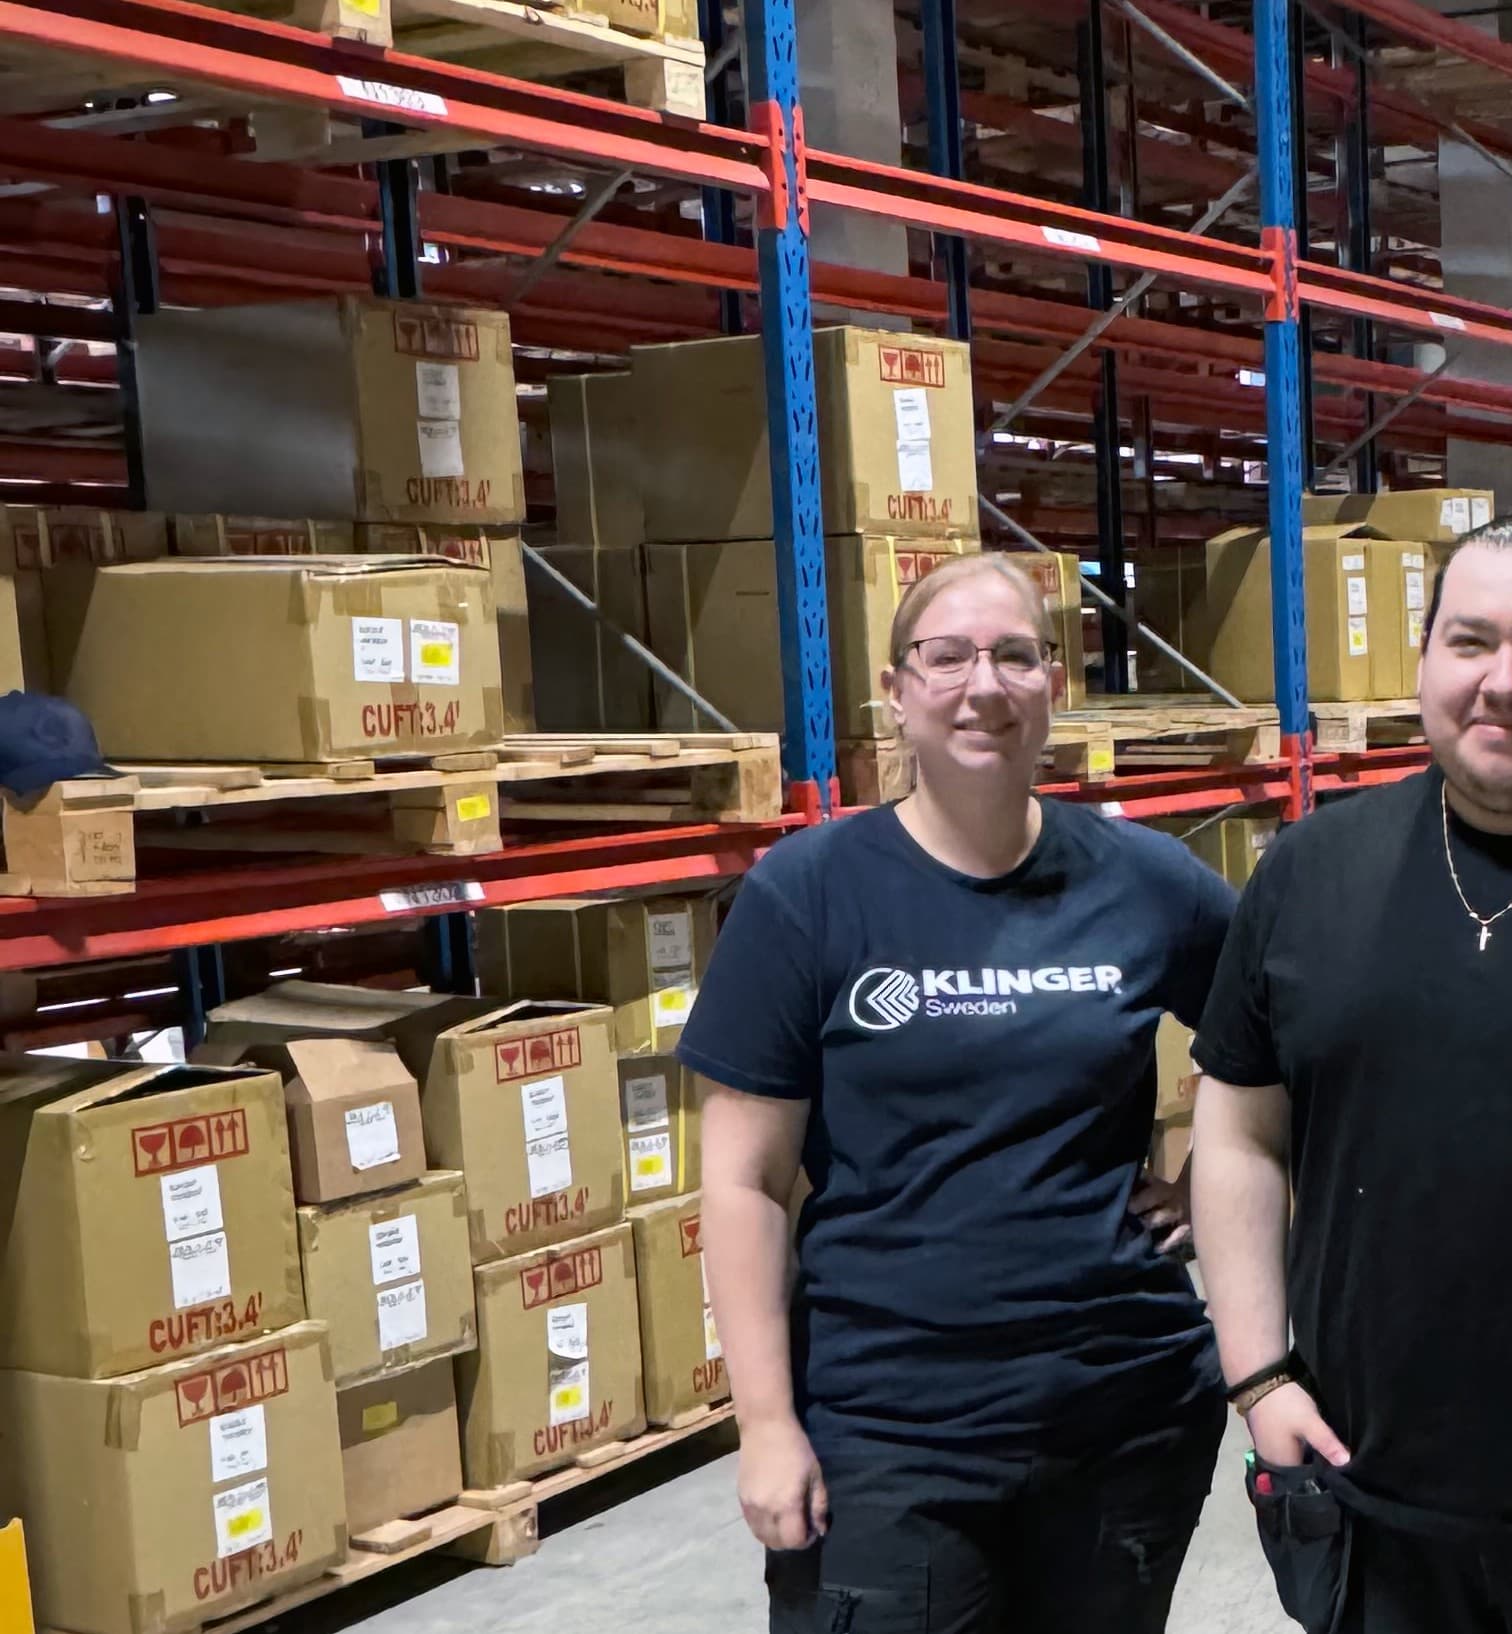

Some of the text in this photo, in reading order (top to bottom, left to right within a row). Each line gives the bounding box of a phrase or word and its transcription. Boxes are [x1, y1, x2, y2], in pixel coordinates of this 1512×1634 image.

[921, 965, 1123, 996] KLINGER
[925, 998, 1017, 1018] Sweden
[149, 1291, 262, 1353] CUFT:3.4'
